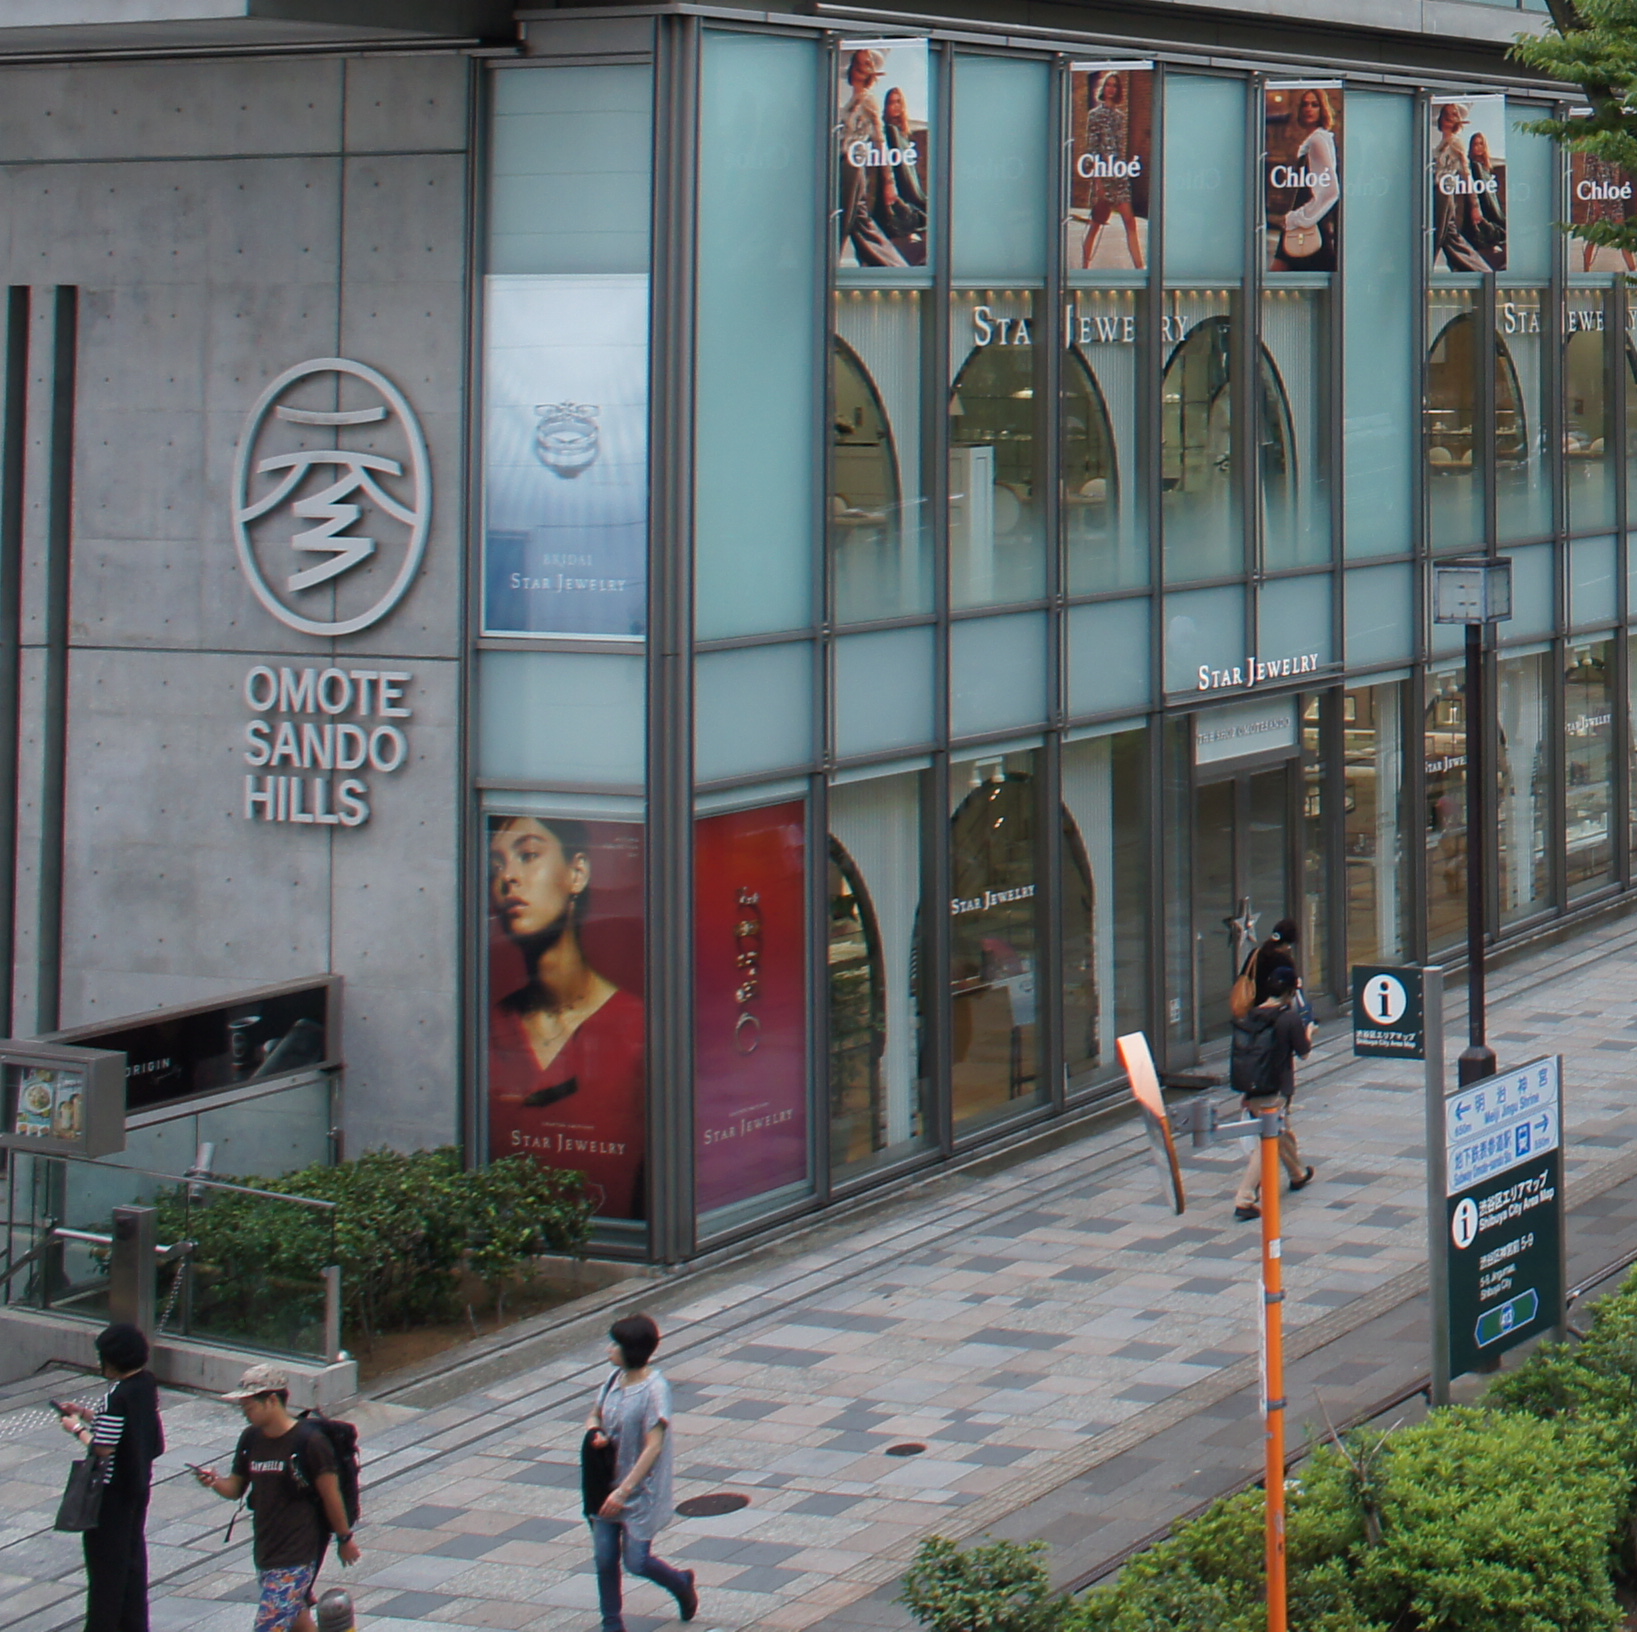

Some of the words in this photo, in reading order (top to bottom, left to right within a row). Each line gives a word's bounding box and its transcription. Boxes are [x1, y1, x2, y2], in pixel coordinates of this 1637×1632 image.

[848, 141, 918, 167] Chloé
[1077, 153, 1141, 178] Chloé
[1271, 165, 1331, 188] Chloé
[1439, 174, 1498, 195] Chloé
[1576, 180, 1632, 200] Chloé
[974, 305, 1032, 347] STA
[1065, 304, 1188, 349] JEWERY
[1504, 302, 1540, 334] STA
[510, 572, 551, 590] STAR
[553, 573, 627, 593] JEWELRY
[1198, 664, 1243, 691] STAR
[1246, 653, 1318, 687] JEWELRY
[245, 665, 413, 717] OMOTE
[245, 720, 409, 772] SANDO
[245, 775, 371, 826] HILLS
[951, 898, 982, 916] STAR
[982, 884, 1036, 911] JEWELRY
[1475, 1067, 1548, 1113] 明治神宮
[511, 1129, 551, 1149] STAR
[556, 1133, 626, 1156] JEWELRY
[703, 1126, 737, 1146] STAR
[740, 1108, 795, 1138] JEWELRY
[1479, 1169, 1549, 1218] 渋谷区エリアマップ
[1479, 1211, 1507, 1232] Shibuya
[1508, 1203, 1522, 1218] City
[1523, 1195, 1540, 1211] Area
[1540, 1186, 1555, 1203] Map
[1521, 1232, 1534, 1251] 5-9
